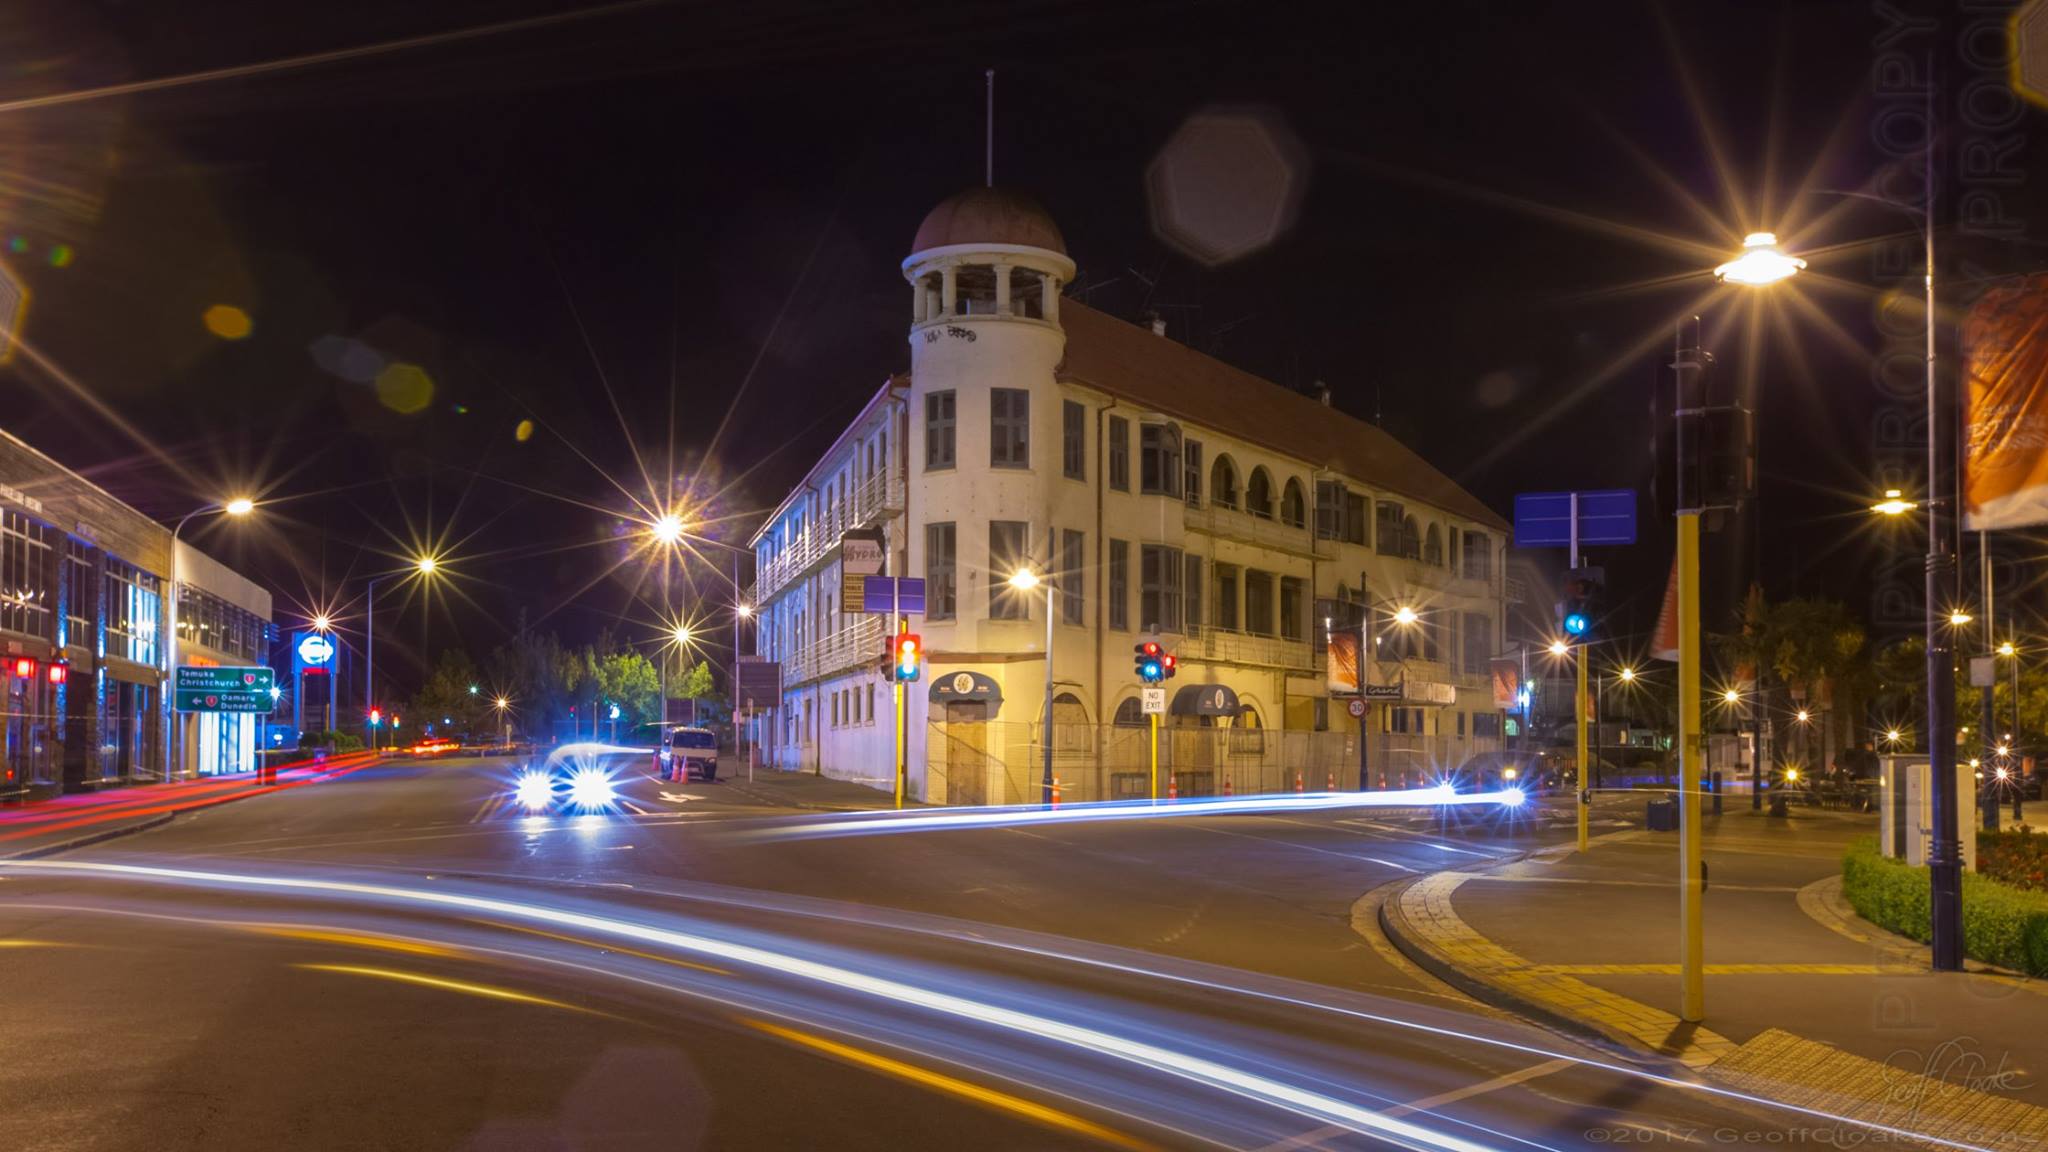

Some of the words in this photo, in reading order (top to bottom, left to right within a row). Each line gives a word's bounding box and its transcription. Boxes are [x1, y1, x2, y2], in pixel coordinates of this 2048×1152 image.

[180, 670, 215, 678] Temuka
[179, 678, 241, 688] Christchurch
[221, 694, 256, 702] Oamaru
[1148, 691, 1159, 699] NO
[220, 702, 257, 710] Dunedin
[1146, 702, 1161, 710] EXIT
[1351, 704, 1362, 712] 30
